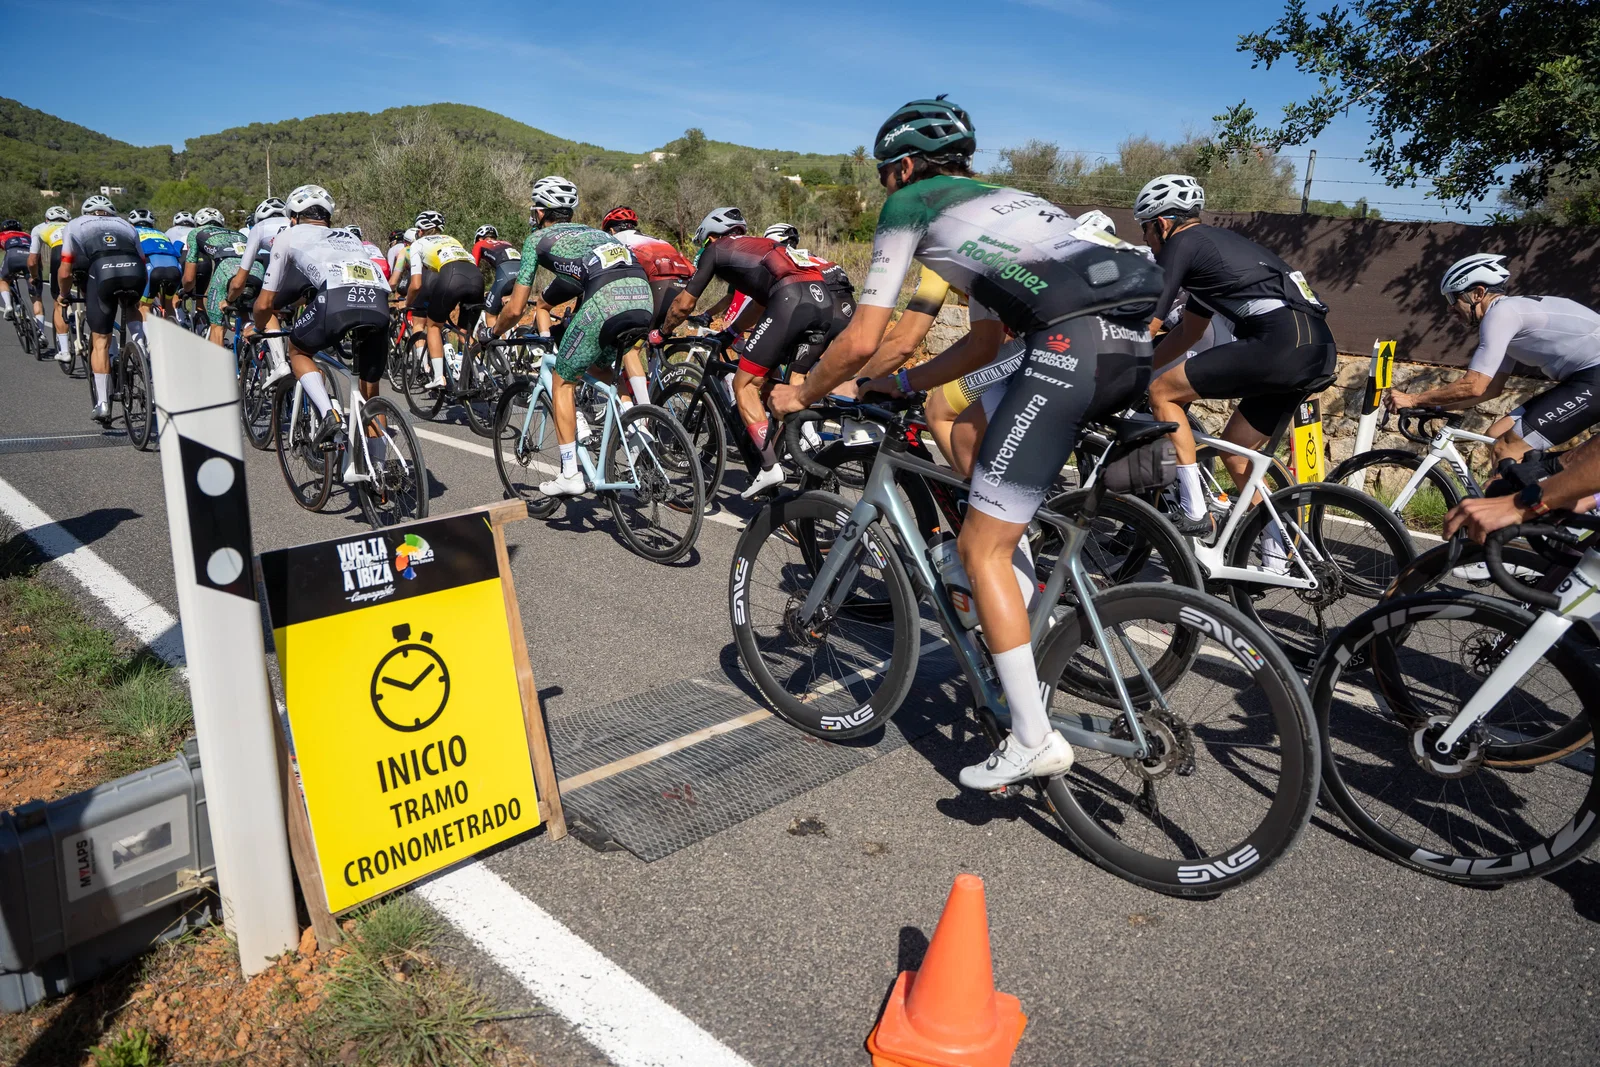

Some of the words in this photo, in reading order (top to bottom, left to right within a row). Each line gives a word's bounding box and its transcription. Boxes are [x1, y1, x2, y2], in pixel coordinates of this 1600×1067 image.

[957, 240, 1049, 295] Rodríguez
[347, 294, 377, 303] BAY
[349, 286, 377, 296] ARA
[294, 304, 318, 329] ARABAY
[745, 317, 773, 352] lobobike
[1032, 348, 1079, 366] DIPUTACIÓN
[1038, 356, 1076, 371] BADAJOZ
[974, 366, 1003, 385] CANTINA
[1031, 371, 1074, 389] SCOTT
[1537, 389, 1593, 426] ARABAY
[983, 393, 1048, 488] Extremadura
[336, 536, 388, 565] VUELTA
[343, 570, 356, 592] A
[356, 562, 395, 589] IBIZA
[376, 734, 468, 794] INICIO
[389, 779, 470, 829] TRAMO
[343, 797, 522, 888] CRONOMETRADO
[76, 838, 92, 888] MYLAPS
